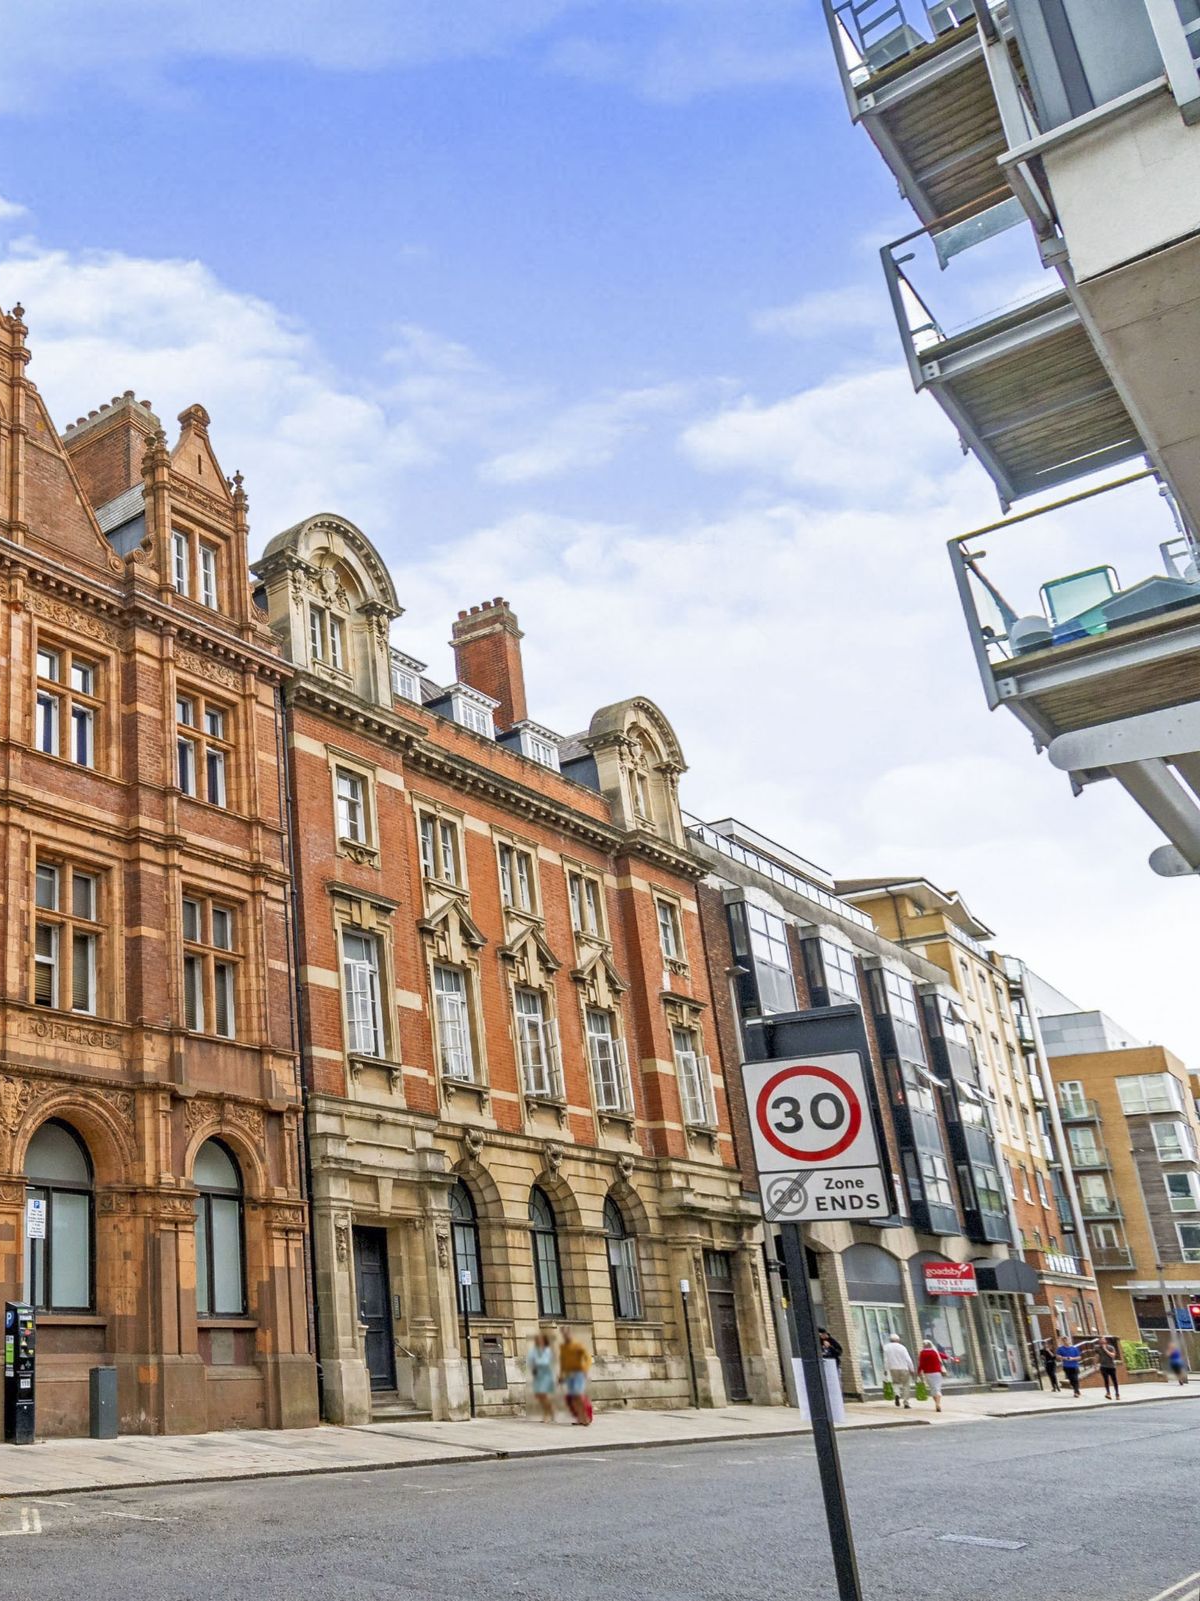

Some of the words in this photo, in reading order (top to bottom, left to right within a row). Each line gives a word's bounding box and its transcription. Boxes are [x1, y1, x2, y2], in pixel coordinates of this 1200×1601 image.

[34, 1021, 117, 1050] OFFICE
[771, 1092, 846, 1134] 30
[823, 1177, 865, 1190] Zone
[815, 1193, 881, 1212] ENDS
